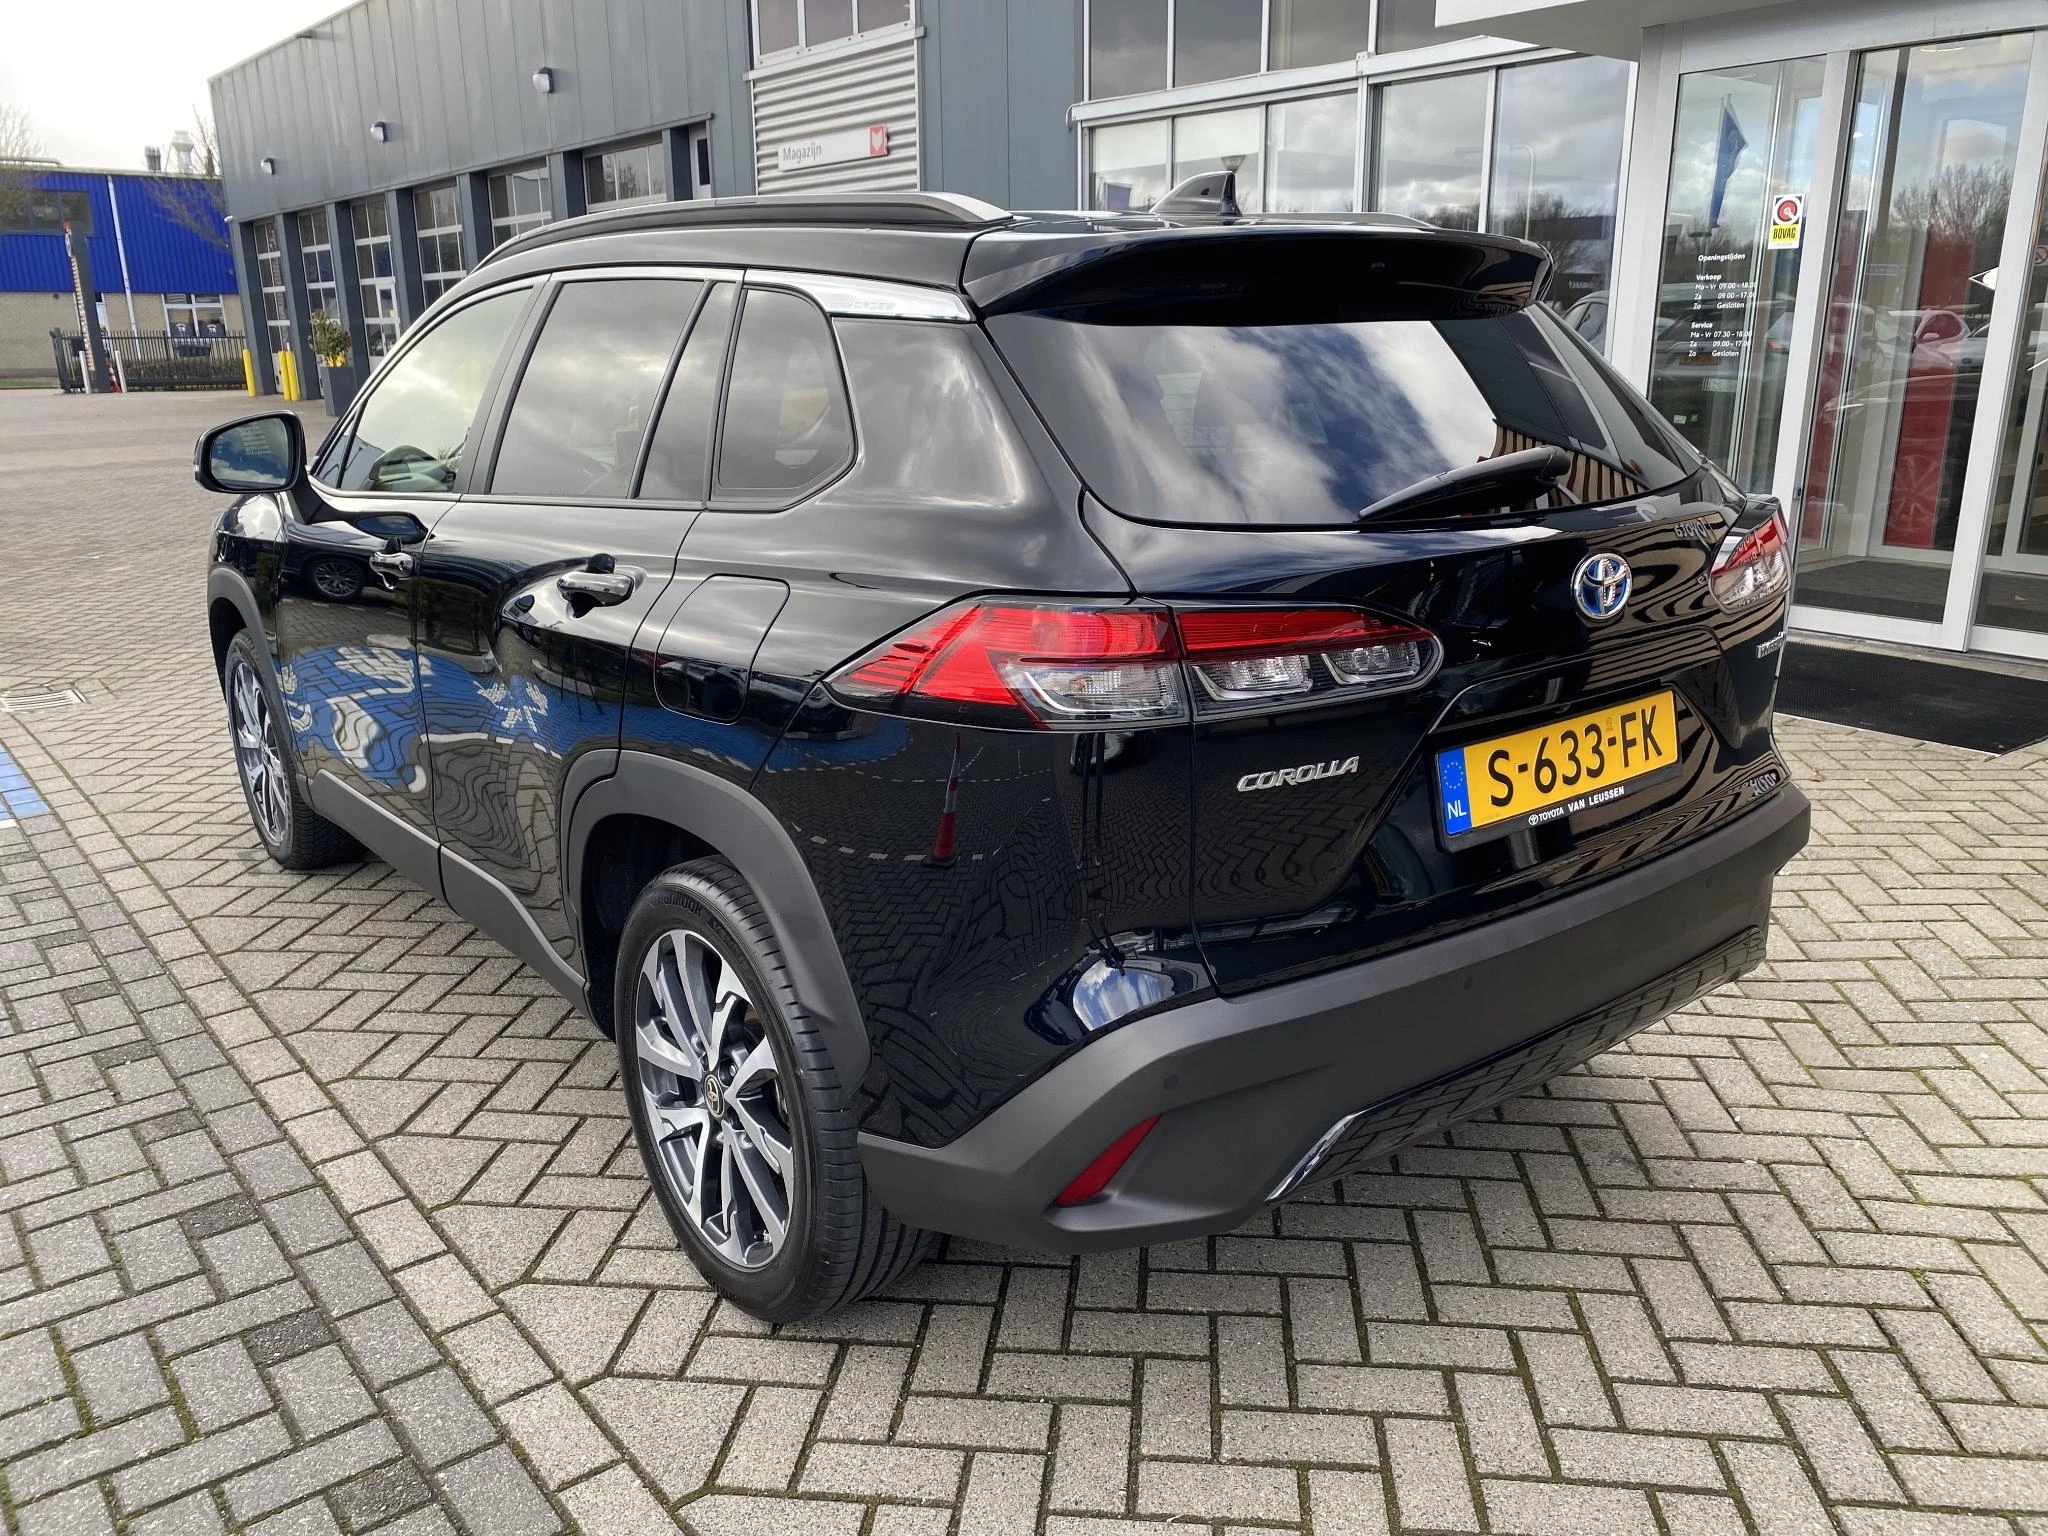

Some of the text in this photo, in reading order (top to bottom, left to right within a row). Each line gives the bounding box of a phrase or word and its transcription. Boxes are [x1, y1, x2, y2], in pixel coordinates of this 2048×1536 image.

[783, 141, 822, 163] Magazijn
[1773, 227, 1796, 239] BOVAG
[1698, 252, 1746, 262] Openingstijden
[1691, 321, 1713, 329] Service
[1713, 330, 1731, 338] 07.30
[1486, 704, 1664, 807] S-633-FK
[1237, 755, 1360, 792] COROLLA
[1447, 799, 1467, 820] NL
[1539, 785, 1625, 822] TOYOTA VAN LEUSSEN
